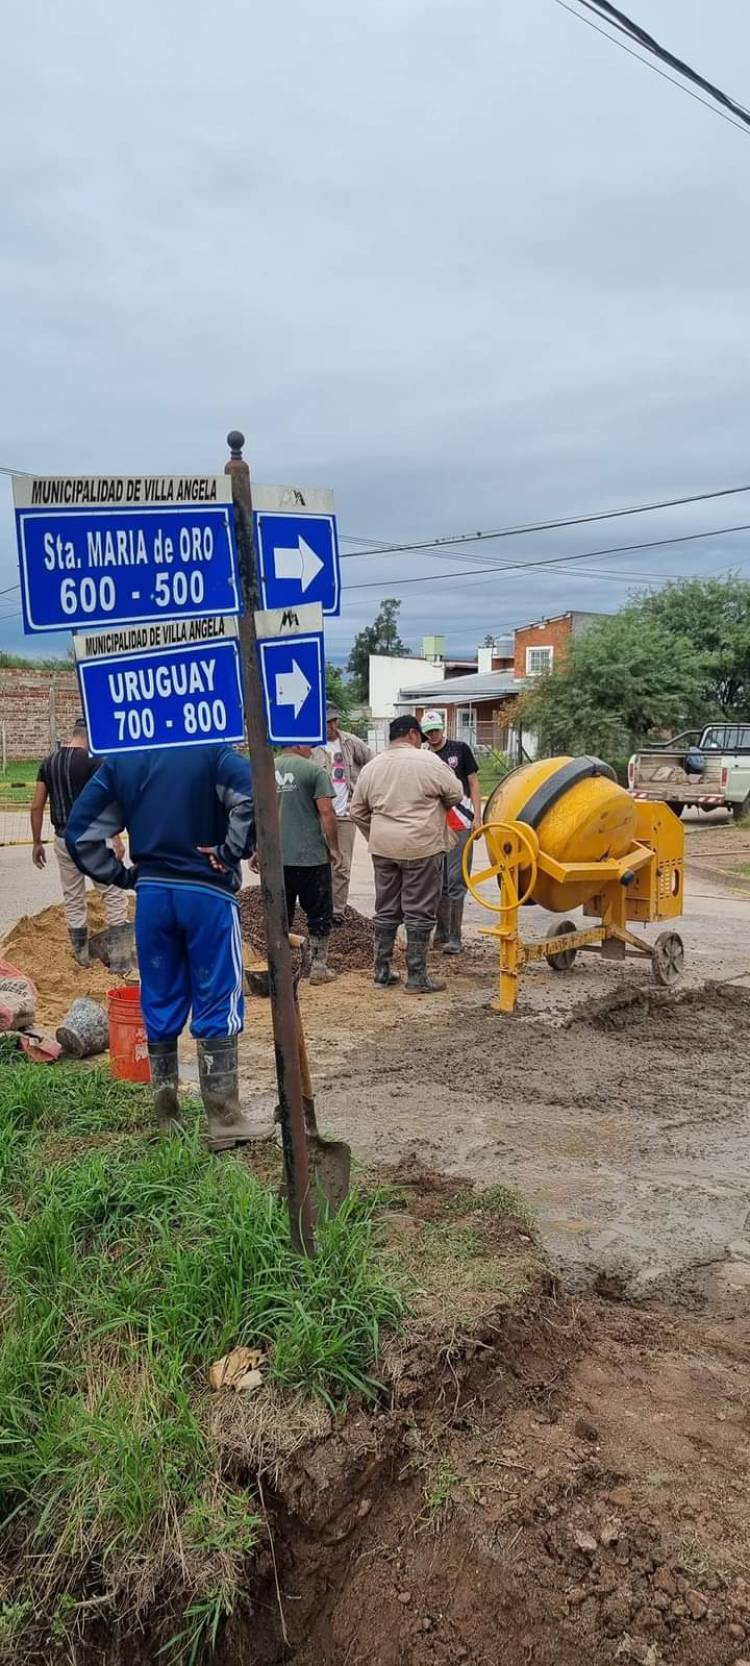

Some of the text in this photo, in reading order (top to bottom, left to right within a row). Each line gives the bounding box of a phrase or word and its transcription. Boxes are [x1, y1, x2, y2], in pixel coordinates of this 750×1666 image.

[31, 478, 217, 504] MUNICIPALIDAD DE VILLA ANGELA
[43, 526, 213, 571] Sta. MARIA de ORO
[60, 576, 116, 615] 600
[155, 570, 204, 607] 500
[85, 617, 225, 656] MUNICIPALIDAD DE VILLA ANGELA
[108, 659, 216, 703] URUGUAY
[114, 708, 155, 741] 700
[183, 699, 227, 734] 800
